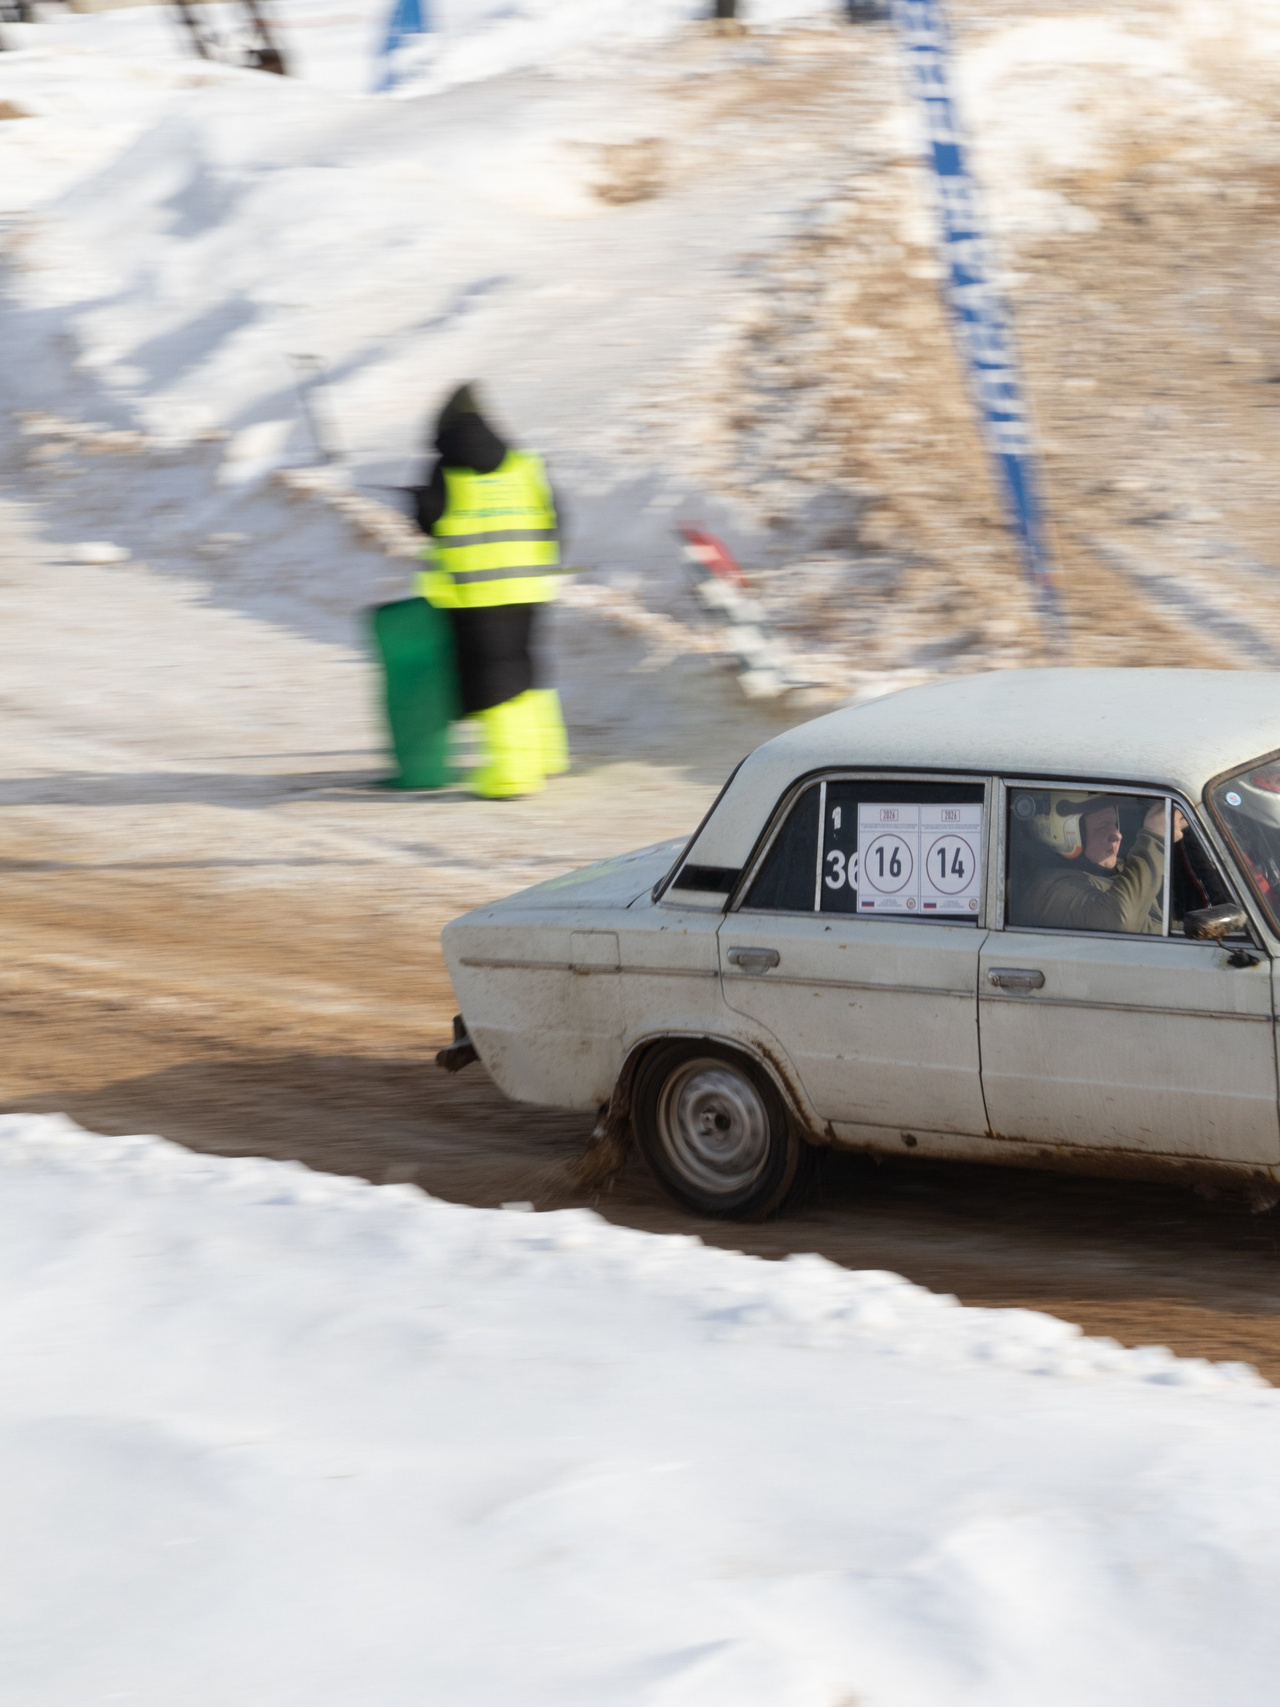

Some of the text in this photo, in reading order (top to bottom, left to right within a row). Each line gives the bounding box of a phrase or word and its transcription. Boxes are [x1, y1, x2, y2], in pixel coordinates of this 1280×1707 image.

[883, 809, 896, 820] 2026
[944, 810, 957, 820] 2026
[875, 846, 902, 878] 16
[937, 847, 965, 879] 14
